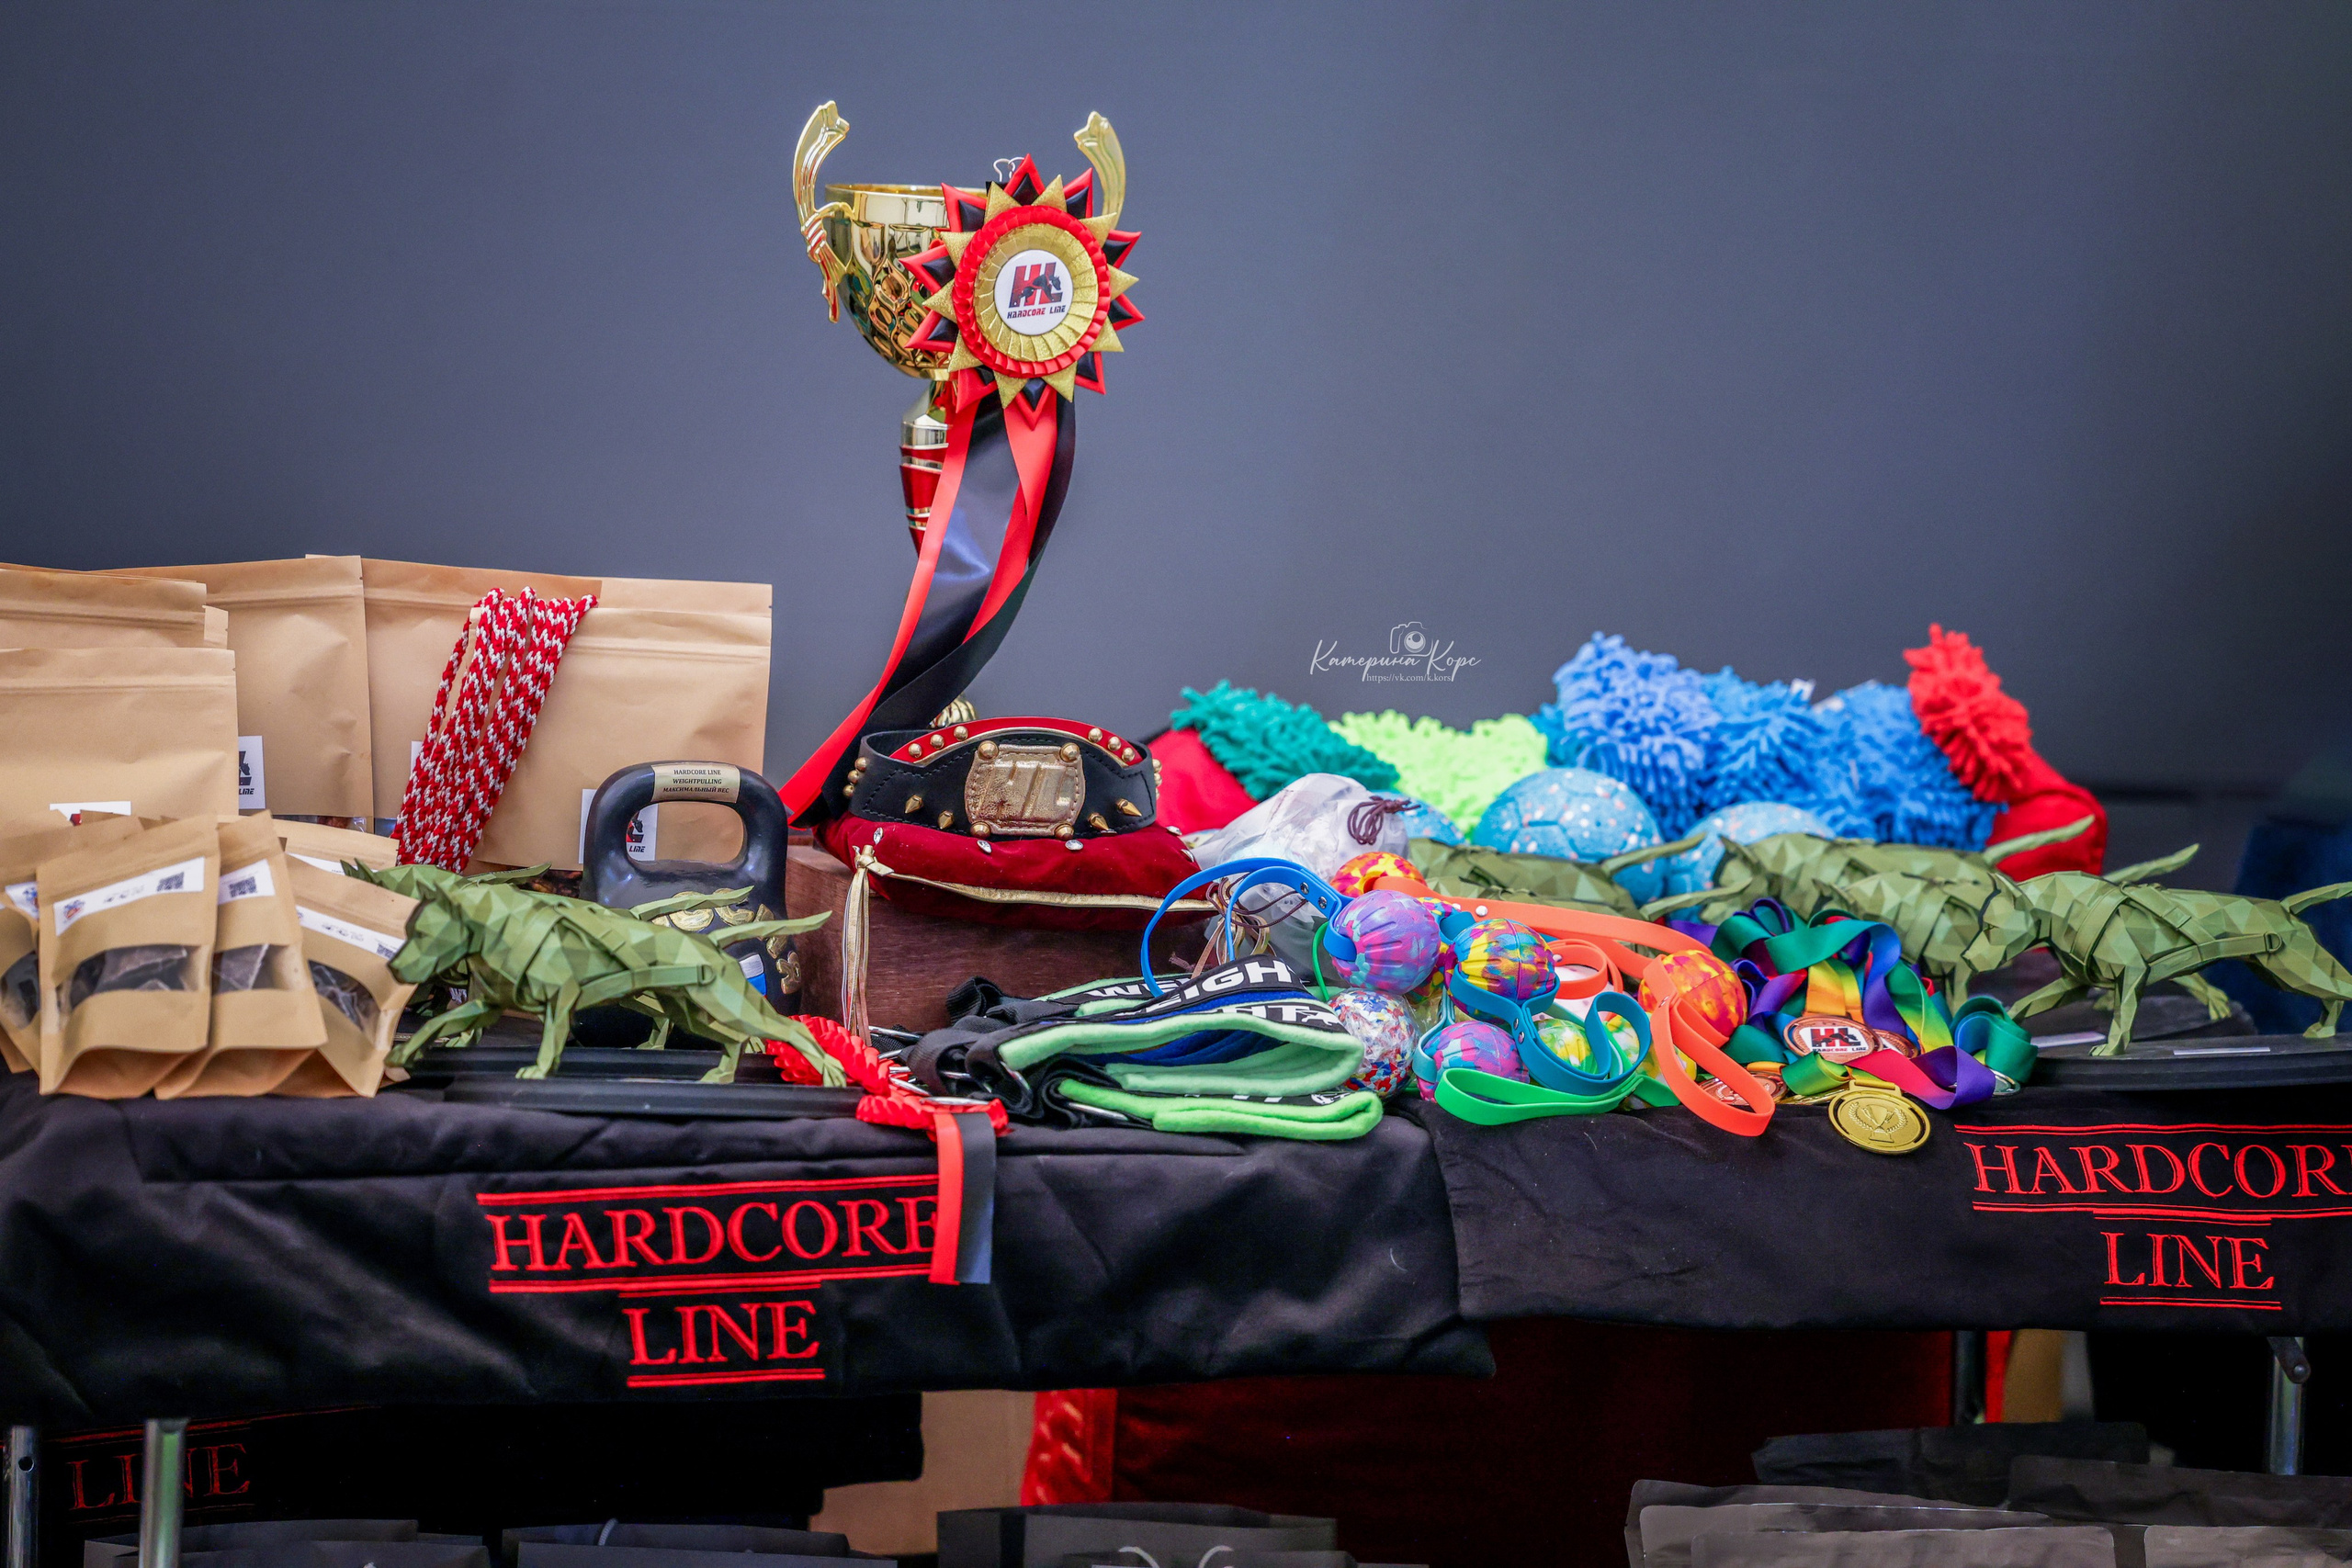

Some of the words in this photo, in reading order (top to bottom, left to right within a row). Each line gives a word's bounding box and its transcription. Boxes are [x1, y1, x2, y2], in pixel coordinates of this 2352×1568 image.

[1007, 308, 1046, 319] HARDCORE
[1049, 305, 1066, 314] LINE
[628, 845, 646, 853] LINE
[1963, 1142, 2352, 1200] HARDCOR
[2100, 1231, 2274, 1290] LINE
[623, 1300, 820, 1366] LINE
[65, 1443, 250, 1511] LIE
